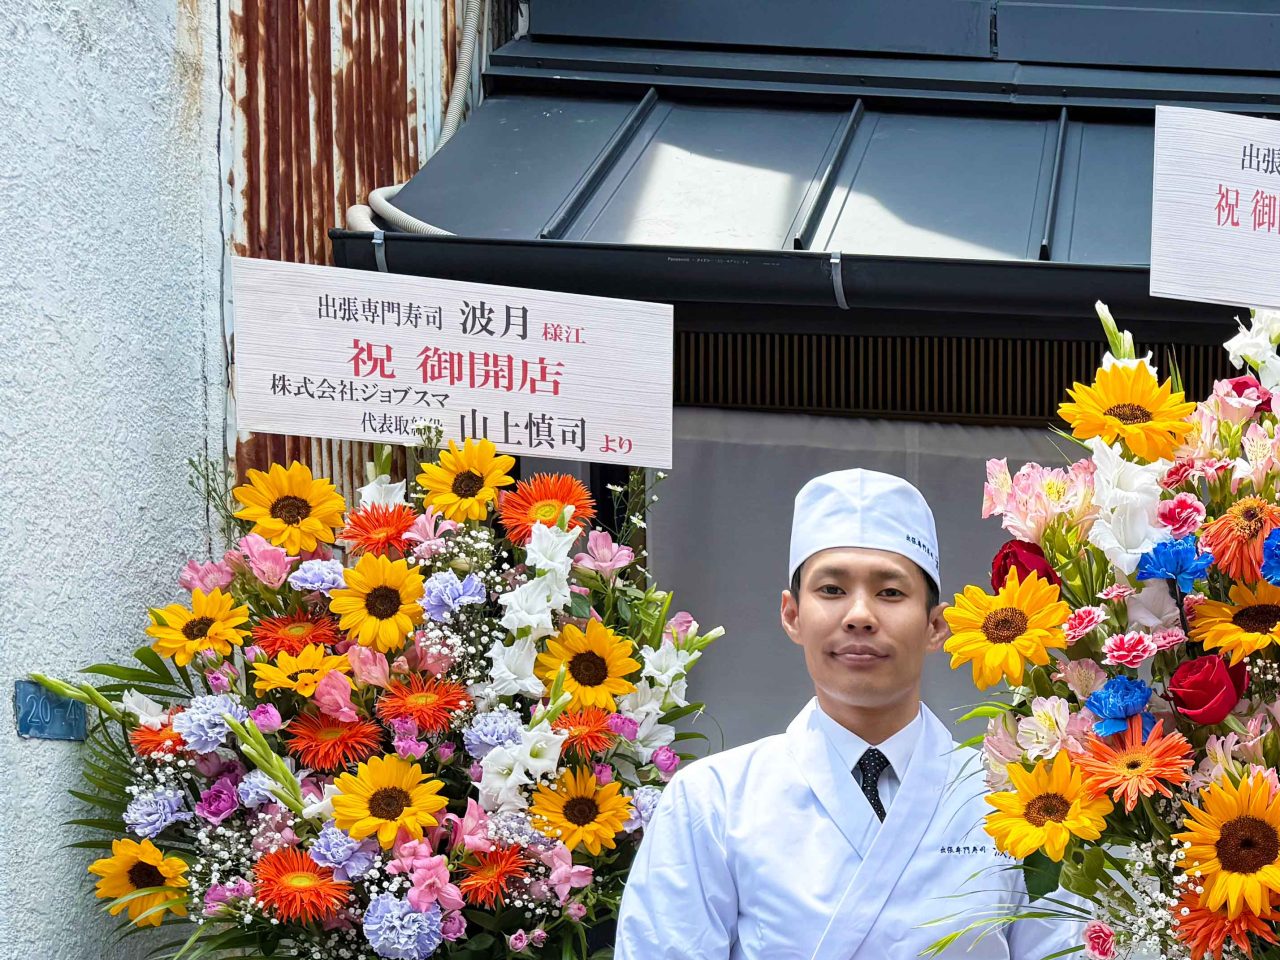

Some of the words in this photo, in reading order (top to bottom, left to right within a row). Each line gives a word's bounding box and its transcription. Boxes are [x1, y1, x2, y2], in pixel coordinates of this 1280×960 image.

[1214, 183, 1240, 227] 祝
[317, 293, 443, 331] 出張専門寿司
[459, 299, 530, 341] 波月
[541, 322, 587, 345] 様江
[346, 338, 397, 380] 祝
[415, 345, 566, 396] 御開店
[269, 373, 450, 409] 株式会社ジョブスマ
[459, 408, 588, 453] 山上慎司
[598, 434, 634, 455] より
[26, 694, 80, 727] 20-4
